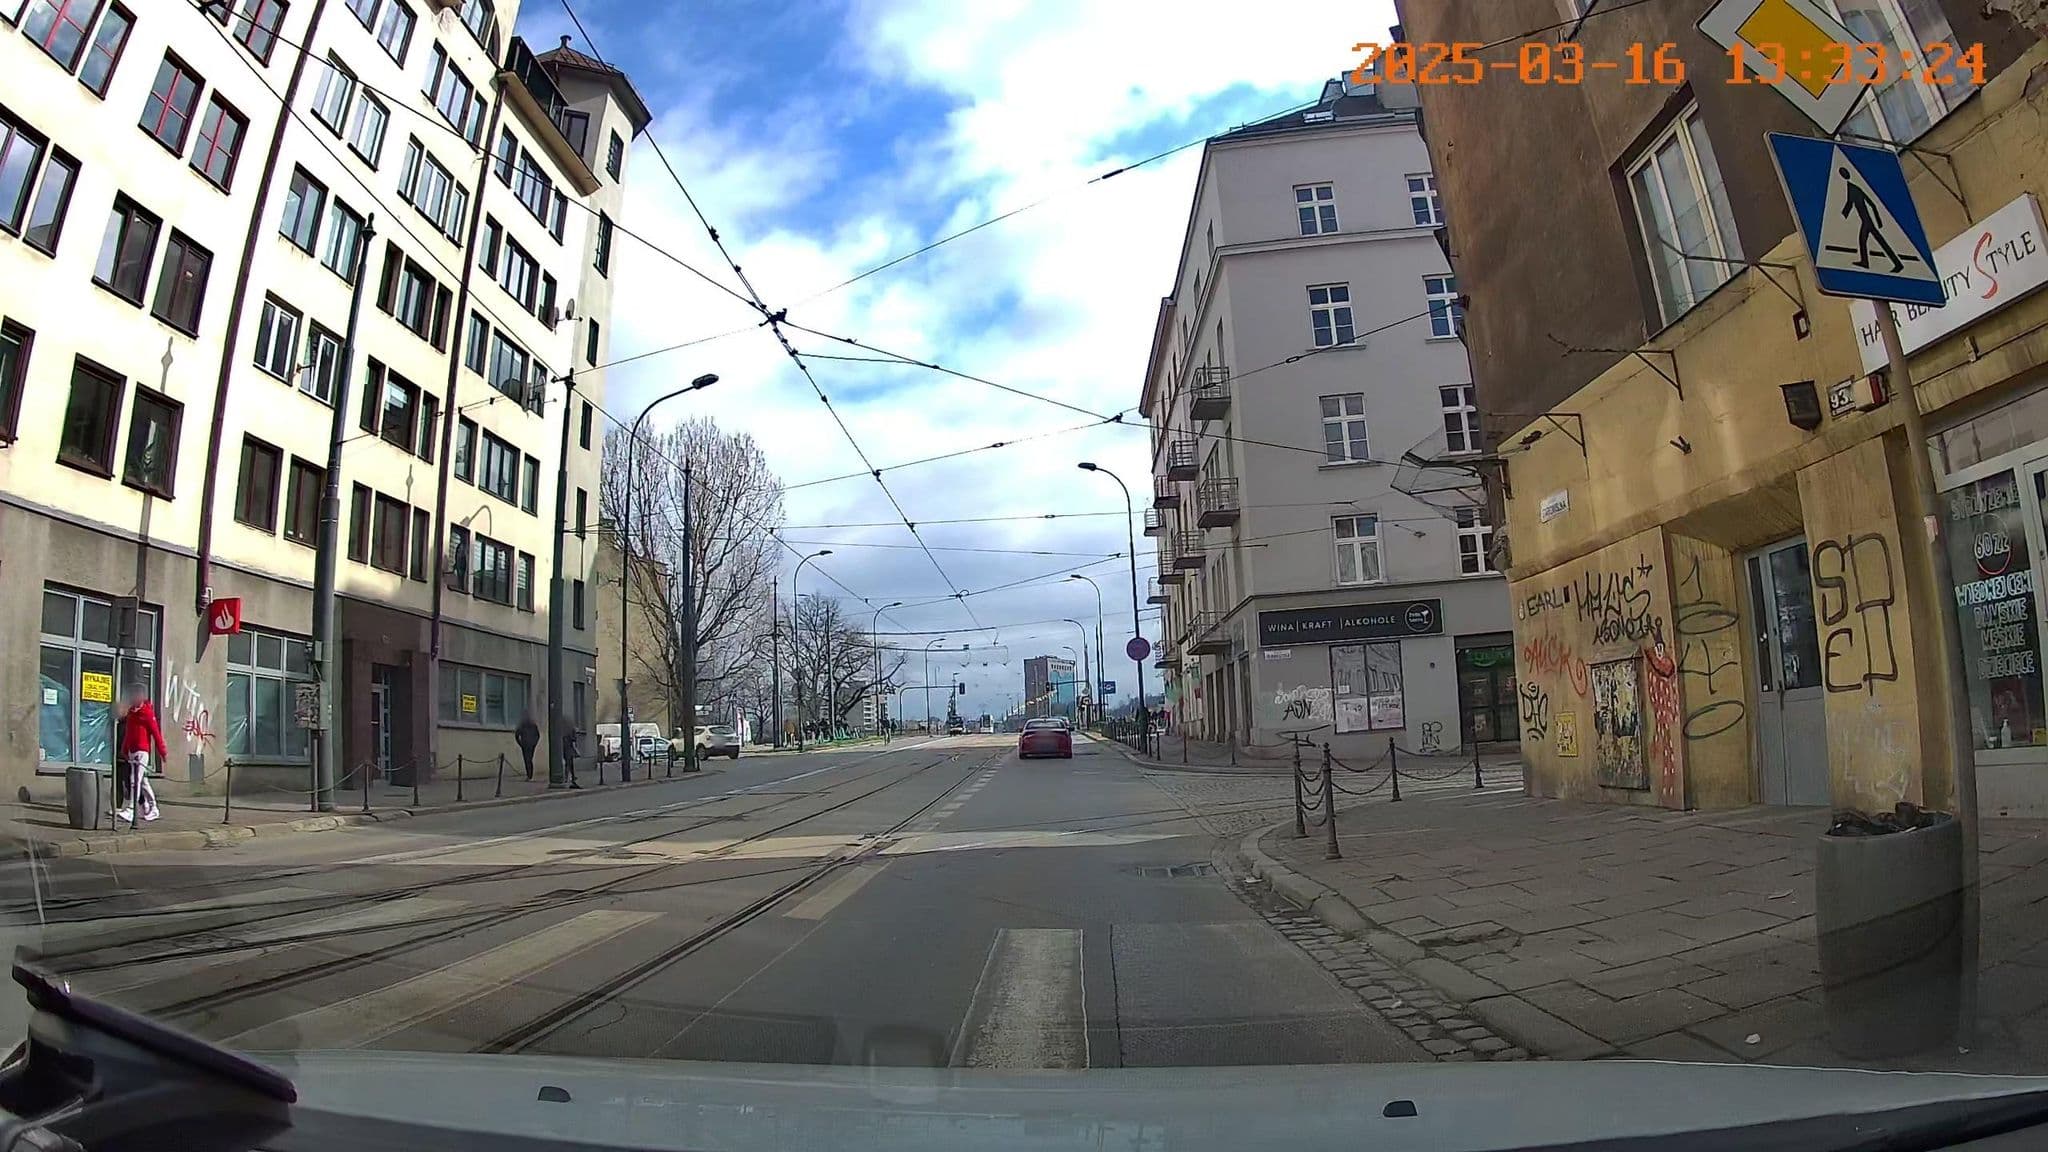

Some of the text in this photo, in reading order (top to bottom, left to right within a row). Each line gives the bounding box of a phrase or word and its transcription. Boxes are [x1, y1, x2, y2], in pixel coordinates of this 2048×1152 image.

[1861, 310, 1902, 346] HAR
[1973, 231, 2036, 300] STYLE
[1267, 615, 1396, 632] WINA KRAFT ALKOHOLE
